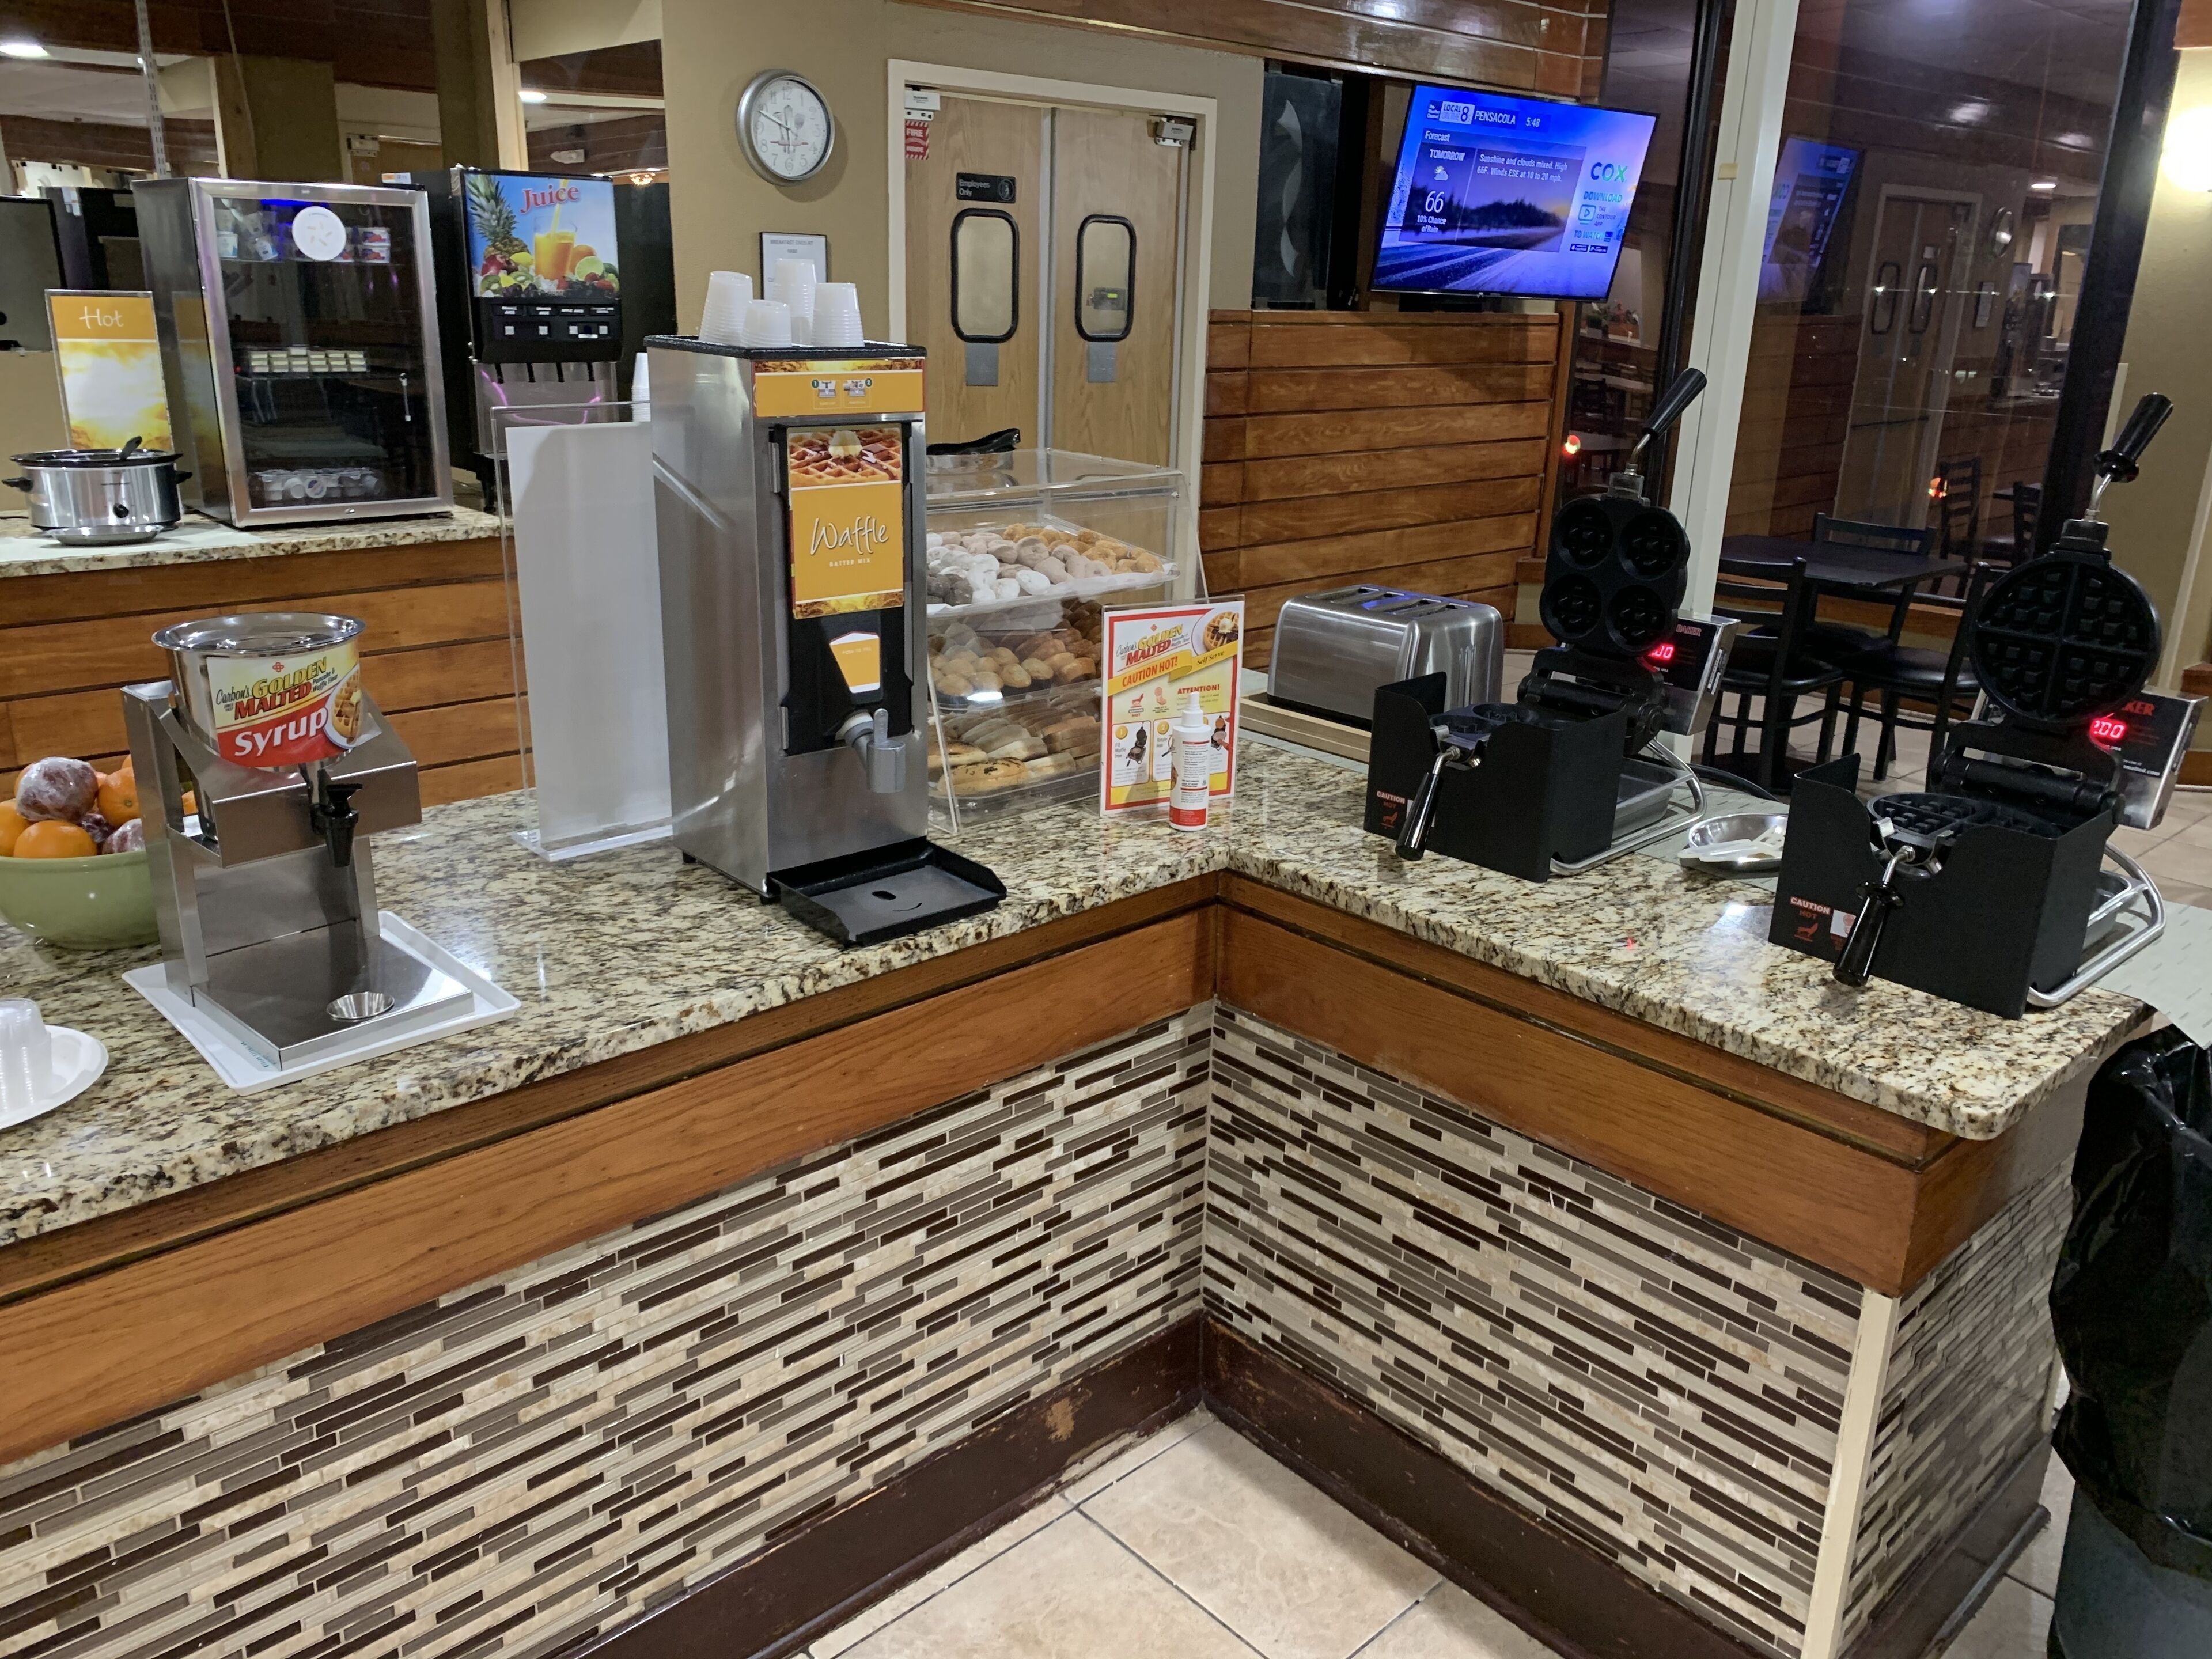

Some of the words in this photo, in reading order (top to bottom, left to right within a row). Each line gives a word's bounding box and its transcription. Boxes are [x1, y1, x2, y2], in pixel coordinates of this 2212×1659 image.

[783, 86, 792, 100] 12
[1443, 104, 1461, 113] LOCAL
[1461, 106, 1469, 122] 8
[1474, 110, 1516, 125] PENSACOLA
[1525, 116, 1541, 128] 5:48
[906, 128, 923, 137] FIRE
[1425, 130, 1450, 142] Forecast
[760, 139, 768, 153] 8
[771, 153, 778, 166] 7
[799, 154, 808, 167] 5
[1430, 149, 1465, 161] TOMORROW
[785, 157, 794, 172] 6
[1479, 154, 1505, 164] Sunshine
[1505, 157, 1517, 166] and
[1517, 158, 1535, 167] clouds
[1536, 161, 1554, 169] mixed.
[1554, 162, 1567, 172] High
[1476, 166, 1489, 175] 66F.
[1490, 167, 1508, 176] Winds
[1508, 169, 1520, 177] ESE
[1520, 171, 1527, 179] at
[1590, 162, 1628, 183] COX
[959, 179, 990, 189] Employees
[520, 184, 579, 214] Juice
[959, 187, 973, 197] Only
[1583, 191, 1623, 203] DOWNLOAD
[1425, 190, 1445, 213] 66
[1574, 230, 1582, 238] TO
[1585, 230, 1605, 240] WATCH
[78, 305, 124, 329] Hot
[810, 515, 889, 555] Waffle
[829, 559, 855, 567] BATTER
[1116, 641, 1137, 657] Carbon's
[1137, 623, 1184, 650] GOLDEN
[1126, 639, 1171, 666] MALTED
[1196, 656, 1209, 666] Self
[1209, 650, 1225, 661] Serve
[313, 671, 331, 684] Pancake
[1122, 664, 1158, 687] CAUTION
[1158, 656, 1178, 673] HOT!
[215, 685, 250, 706] Carbon's
[251, 656, 327, 699] GOLDEN
[313, 680, 327, 692] Waffle
[328, 673, 338, 684] Flour
[1177, 684, 1220, 694] ATTENTION!
[234, 681, 312, 721] MALTED
[2122, 700, 2156, 717] KER
[234, 706, 328, 757] Syrup
[1376, 790, 1406, 804] CAUTION
[1790, 896, 1831, 915] CAUTION
[1799, 910, 1817, 919] HOT
